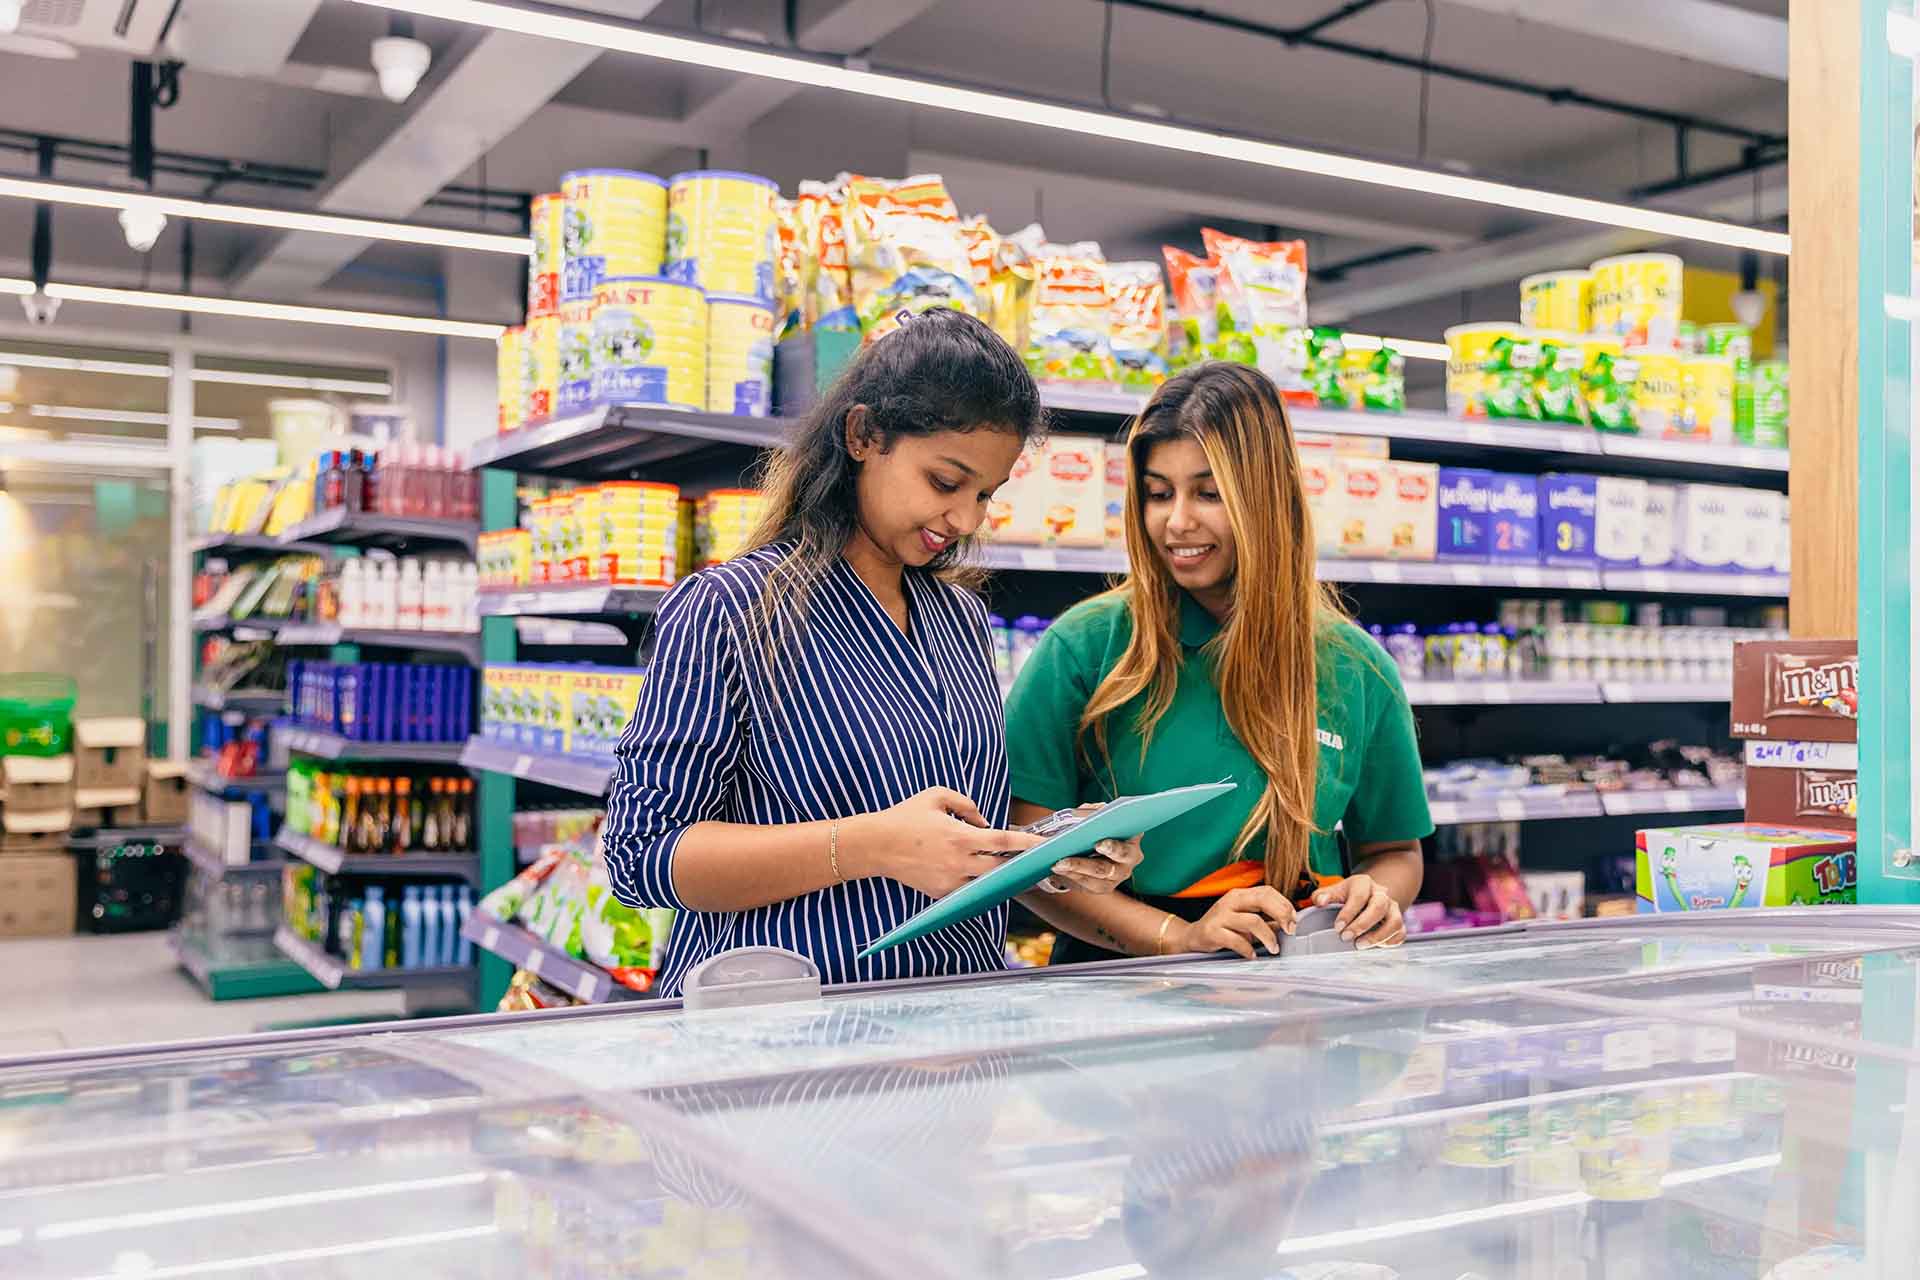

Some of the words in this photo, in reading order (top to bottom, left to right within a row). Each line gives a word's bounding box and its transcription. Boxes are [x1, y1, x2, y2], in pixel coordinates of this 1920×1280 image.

[1451, 517, 1462, 545] 1
[1495, 521, 1511, 549] 2
[1557, 521, 1572, 550] 3
[1782, 661, 1857, 702] m&m
